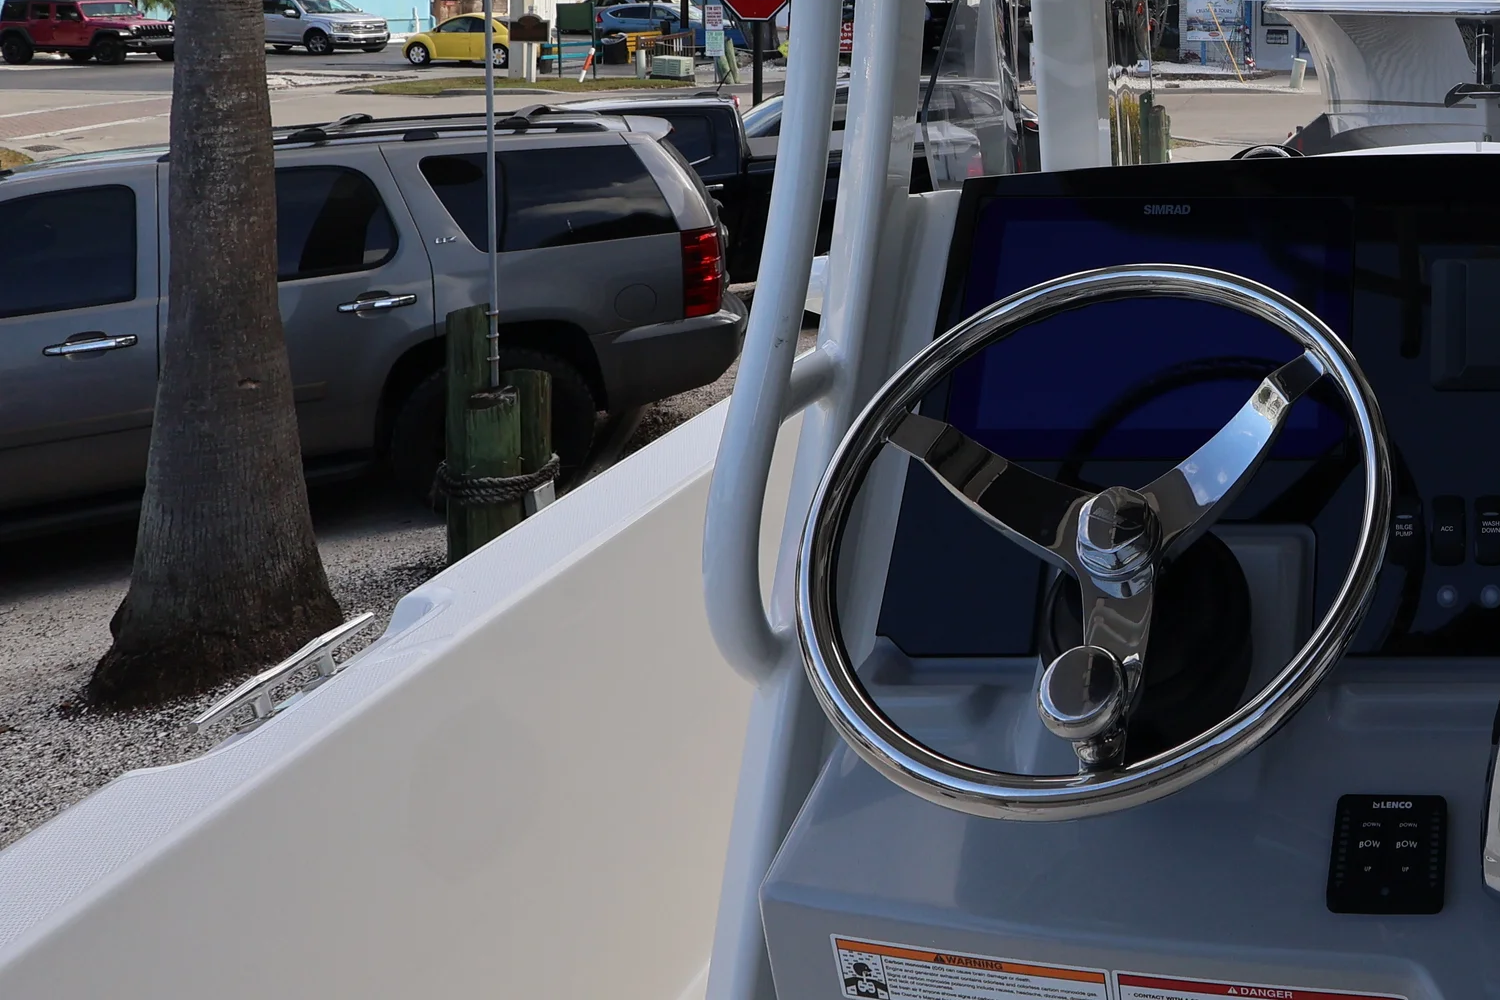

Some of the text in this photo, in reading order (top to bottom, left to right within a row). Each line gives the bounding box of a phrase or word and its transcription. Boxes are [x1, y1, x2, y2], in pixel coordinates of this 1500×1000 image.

[1144, 205, 1191, 214] SIMRAD
[1359, 840, 1380, 848] BOW
[1396, 840, 1418, 849] BOW
[945, 955, 1003, 970] WARNING
[1133, 992, 1164, 1000] CONTACT
[1240, 988, 1293, 999] DANGER
